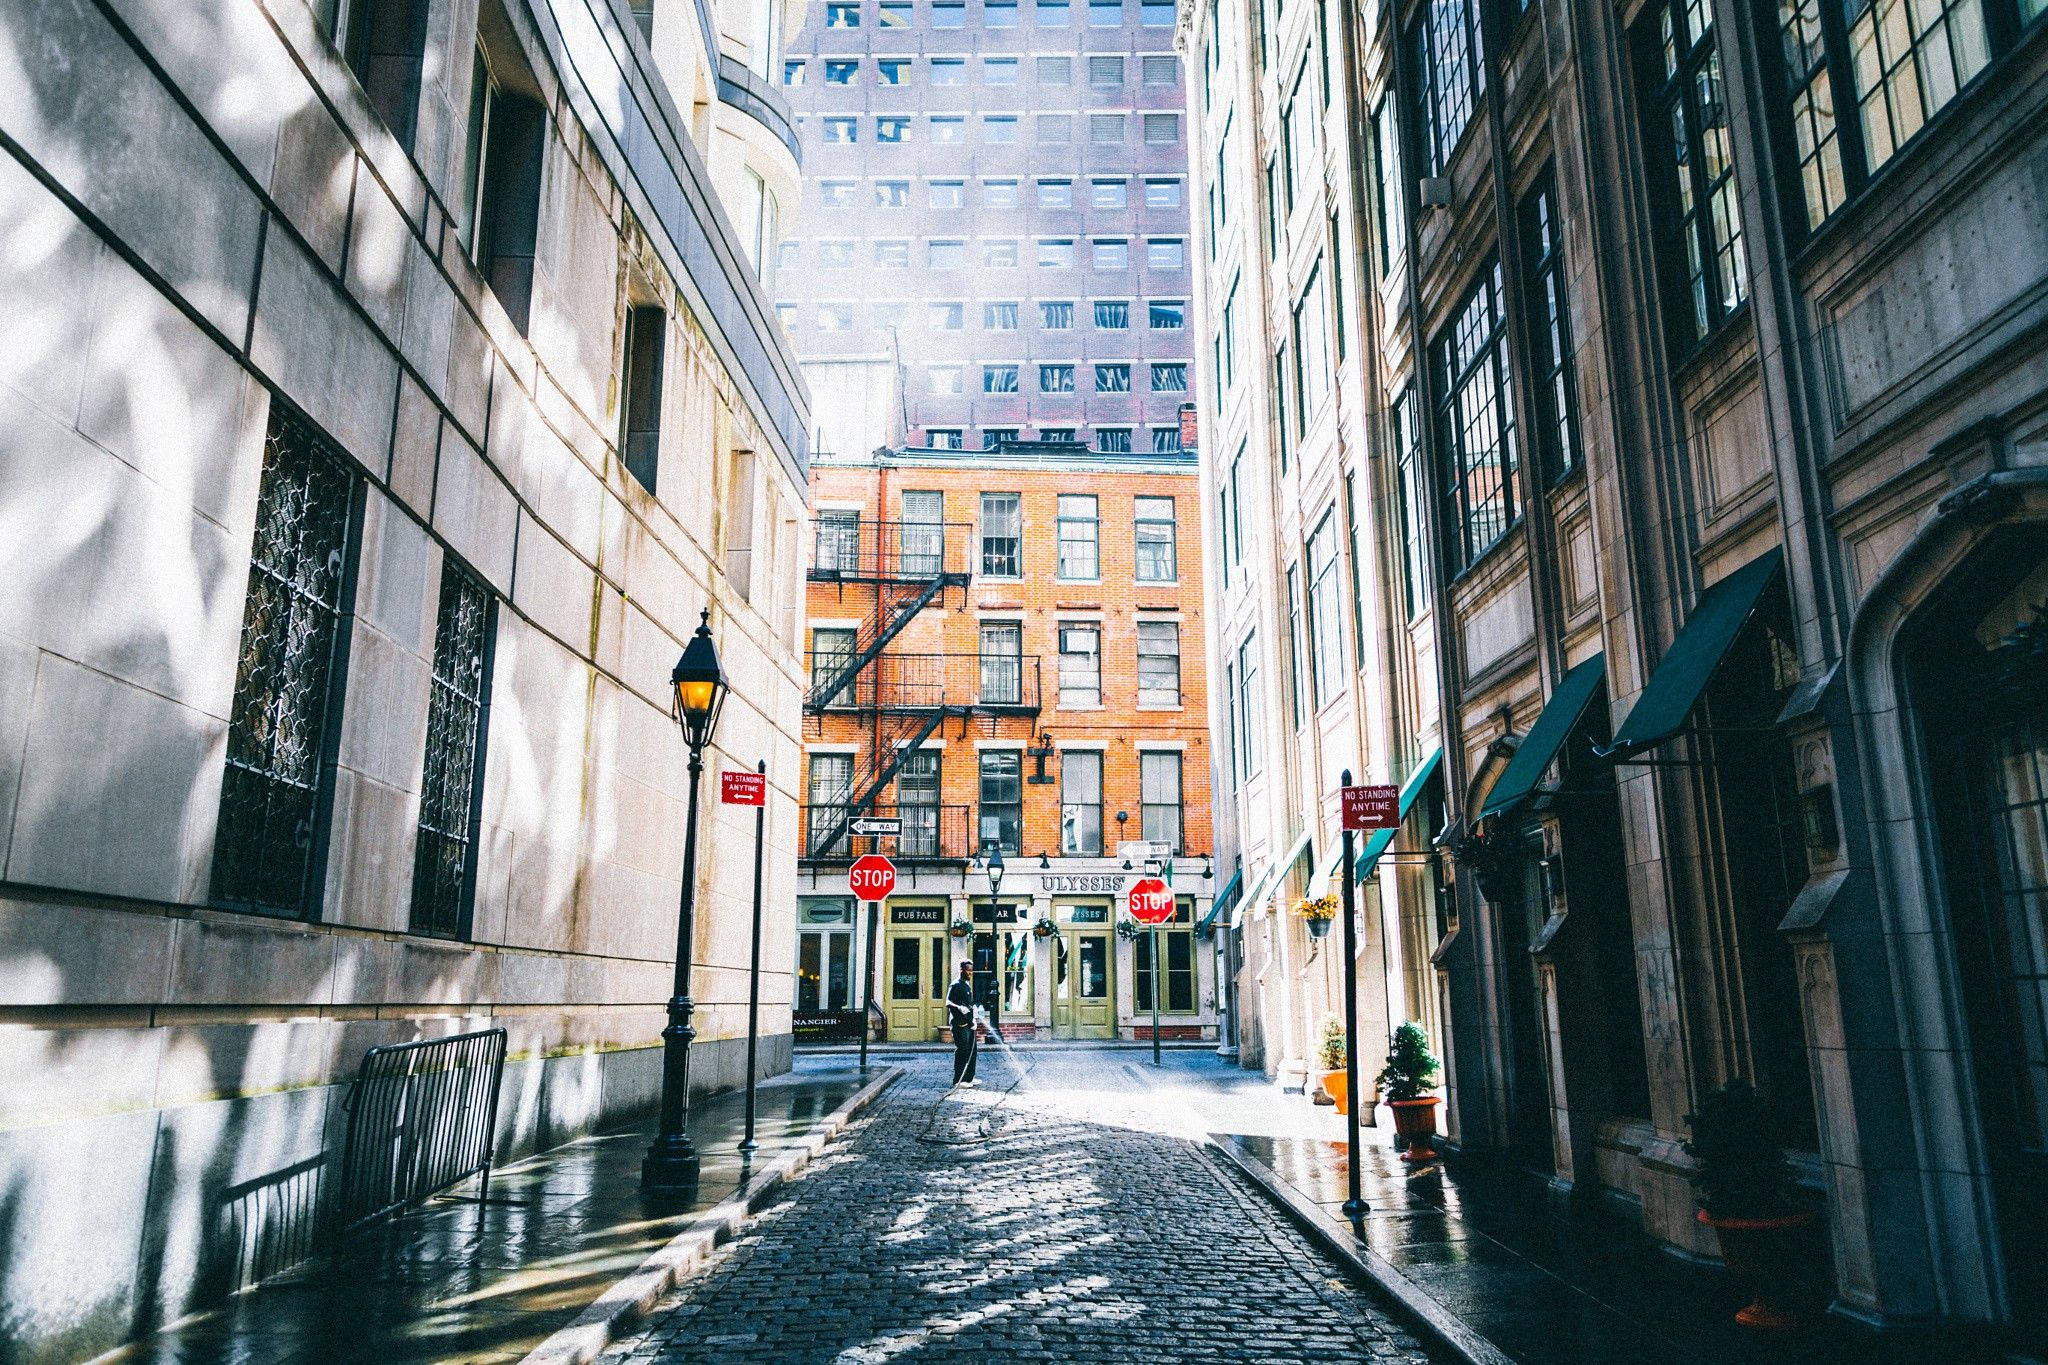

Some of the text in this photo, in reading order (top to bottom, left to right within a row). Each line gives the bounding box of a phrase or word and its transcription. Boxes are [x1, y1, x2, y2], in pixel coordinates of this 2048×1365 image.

[735, 775, 764, 784] STANDING
[729, 783, 759, 793] ANYTIME
[1345, 789, 1396, 800] NO STANDING
[1351, 801, 1391, 812] ANYTIME
[856, 822, 896, 831] ONE WAY
[1150, 846, 1167, 854] WAY
[851, 869, 893, 888] STOP
[1131, 893, 1172, 911] STOP
[898, 911, 938, 919] PUB FARE
